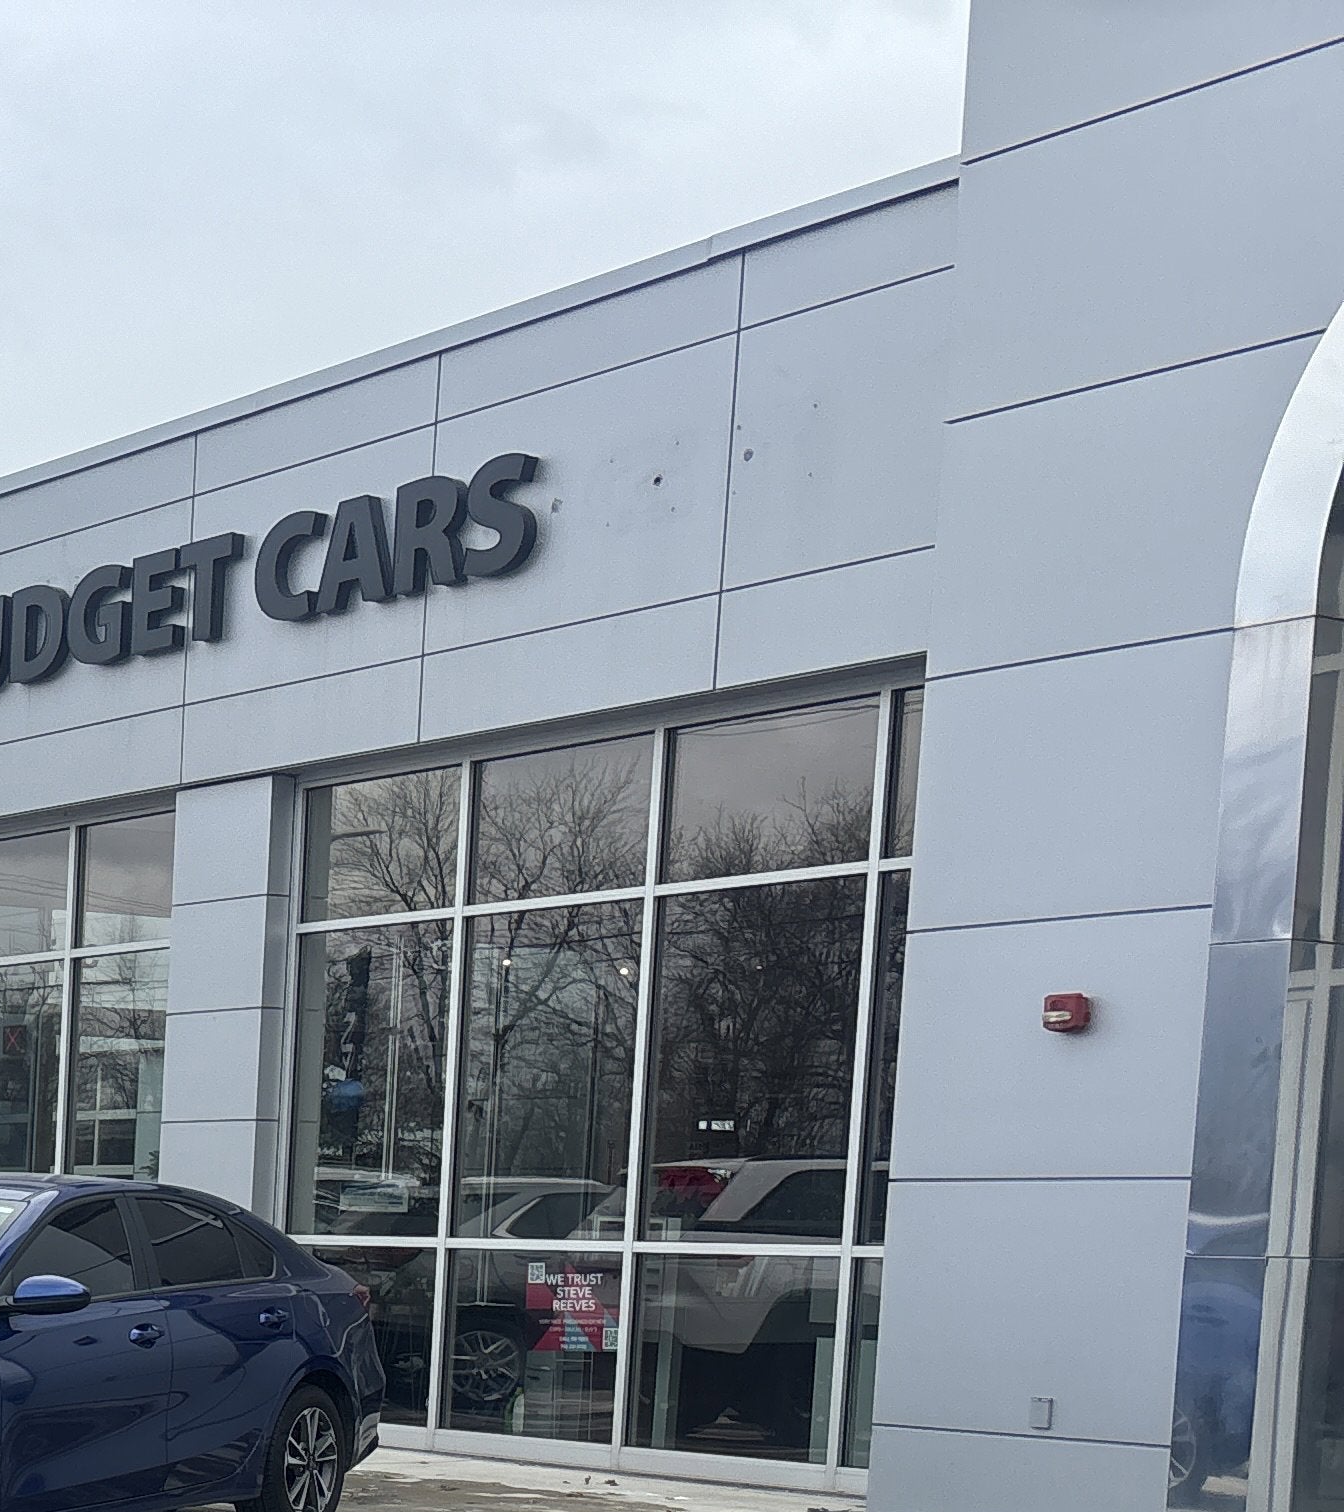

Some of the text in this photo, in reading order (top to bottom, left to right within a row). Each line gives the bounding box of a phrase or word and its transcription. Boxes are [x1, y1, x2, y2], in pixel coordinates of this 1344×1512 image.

[255, 453, 538, 621] CARS
[545, 1273, 603, 1286] WE TRUST
[556, 1287, 592, 1299] STEVE
[552, 1300, 596, 1312] REEVES
